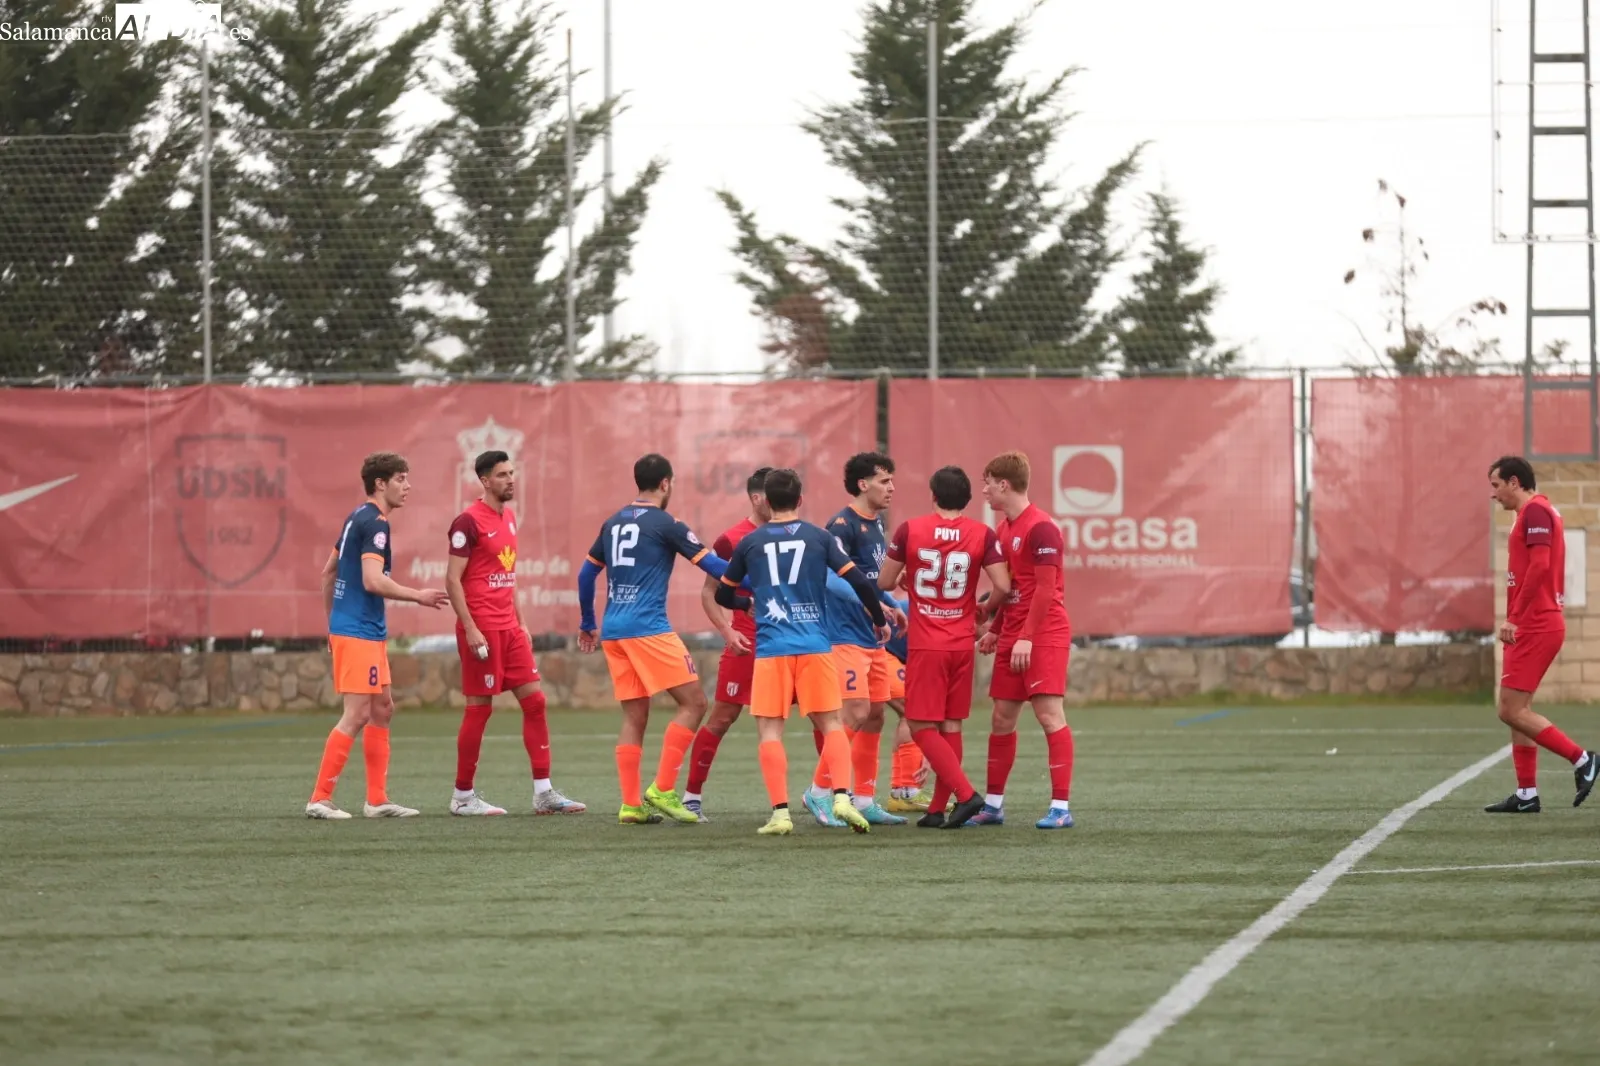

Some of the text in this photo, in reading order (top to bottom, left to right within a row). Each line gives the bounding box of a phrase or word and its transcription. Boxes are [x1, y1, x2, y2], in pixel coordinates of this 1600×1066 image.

[176, 466, 286, 499] UDSM
[934, 527, 960, 541] PUYI
[611, 523, 640, 567] 12
[549, 556, 570, 576] de
[763, 539, 806, 587] 17
[914, 548, 971, 600] 28
[531, 585, 580, 606] Torm
[927, 604, 963, 616] Limcasa
[368, 666, 378, 687] 8
[846, 669, 857, 691] 2
